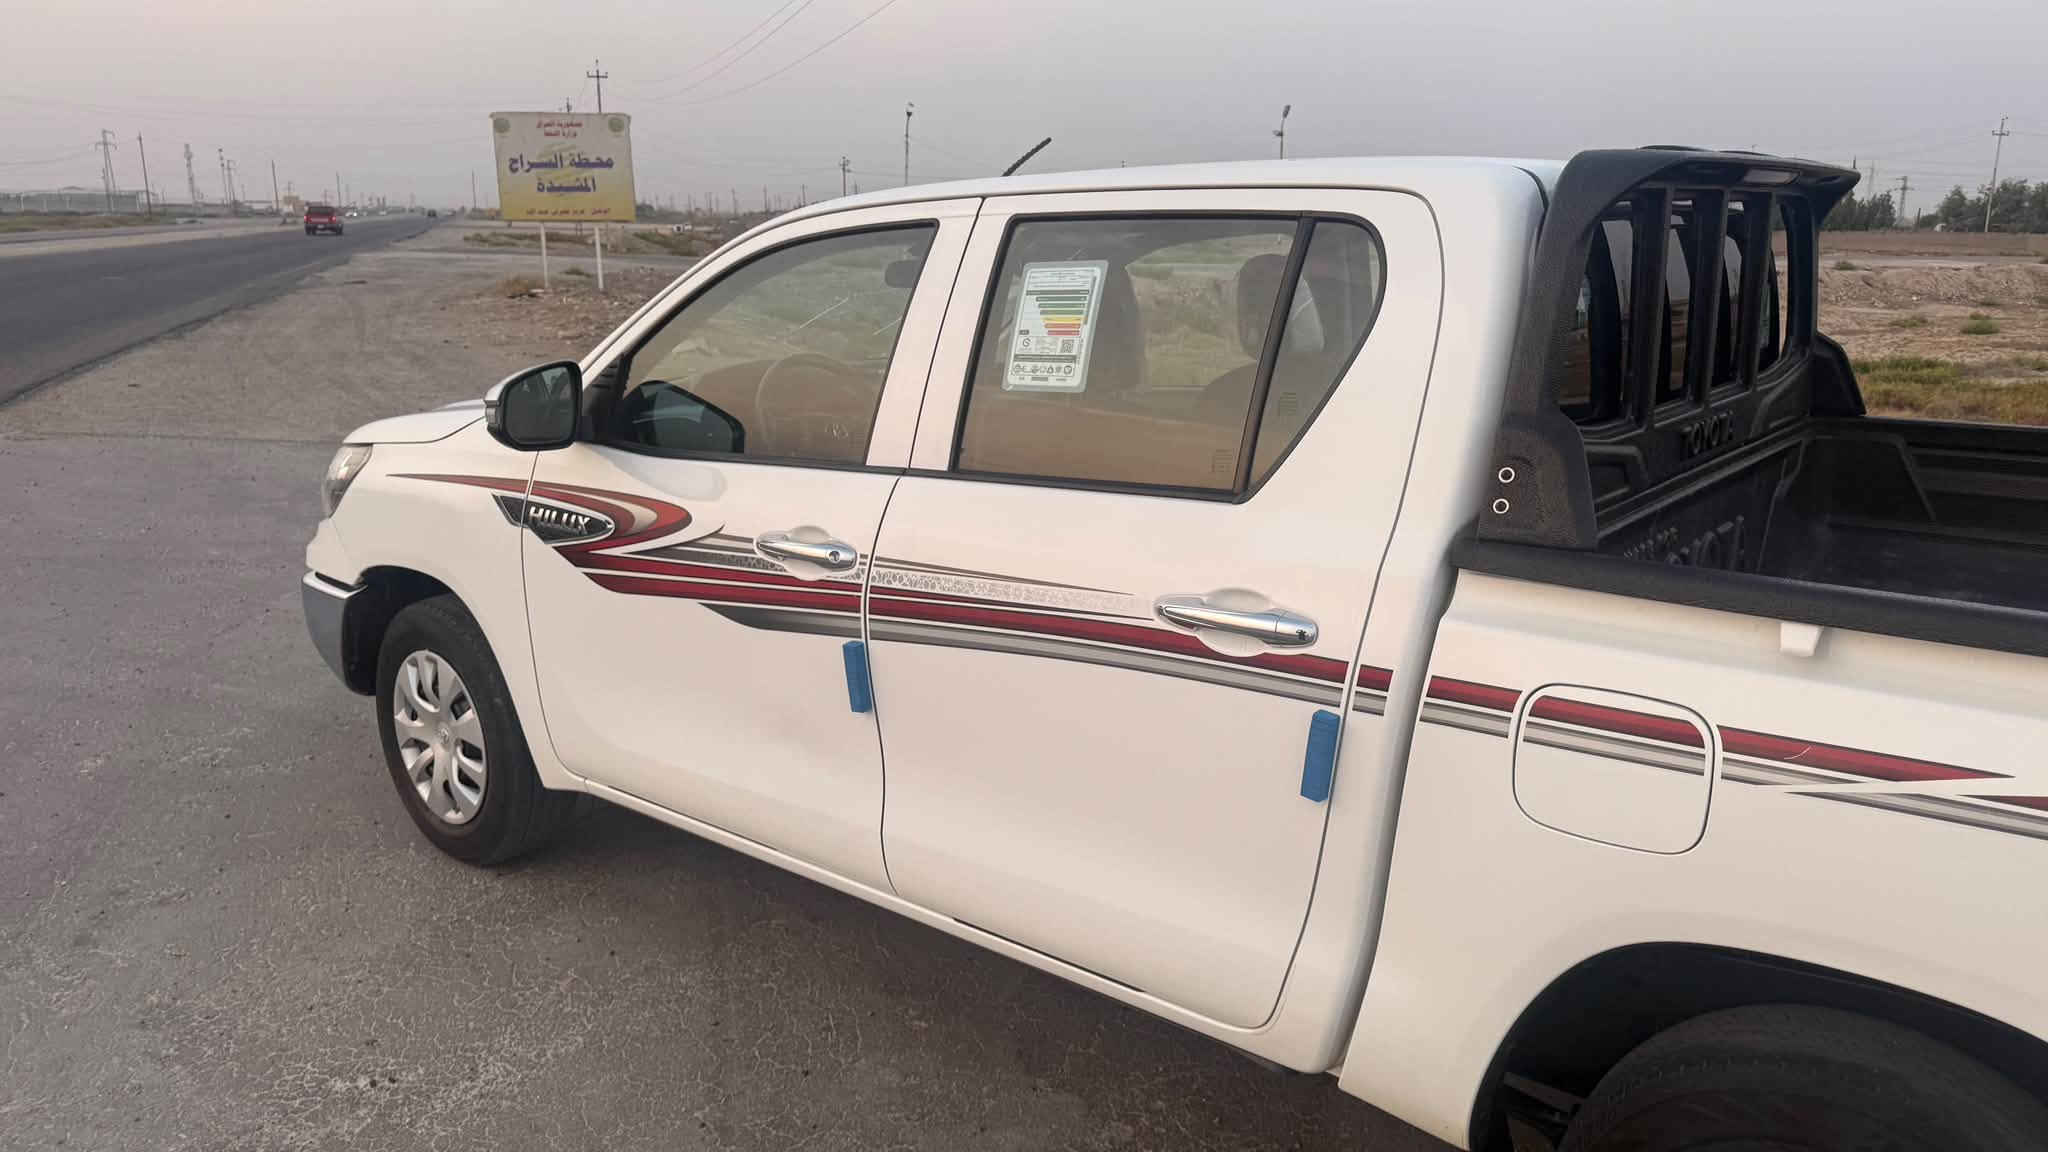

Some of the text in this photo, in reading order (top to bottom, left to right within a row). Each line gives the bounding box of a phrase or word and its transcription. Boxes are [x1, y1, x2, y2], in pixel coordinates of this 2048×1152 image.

[508, 151, 614, 173] محطة السراج
[529, 505, 591, 535] HILUX
